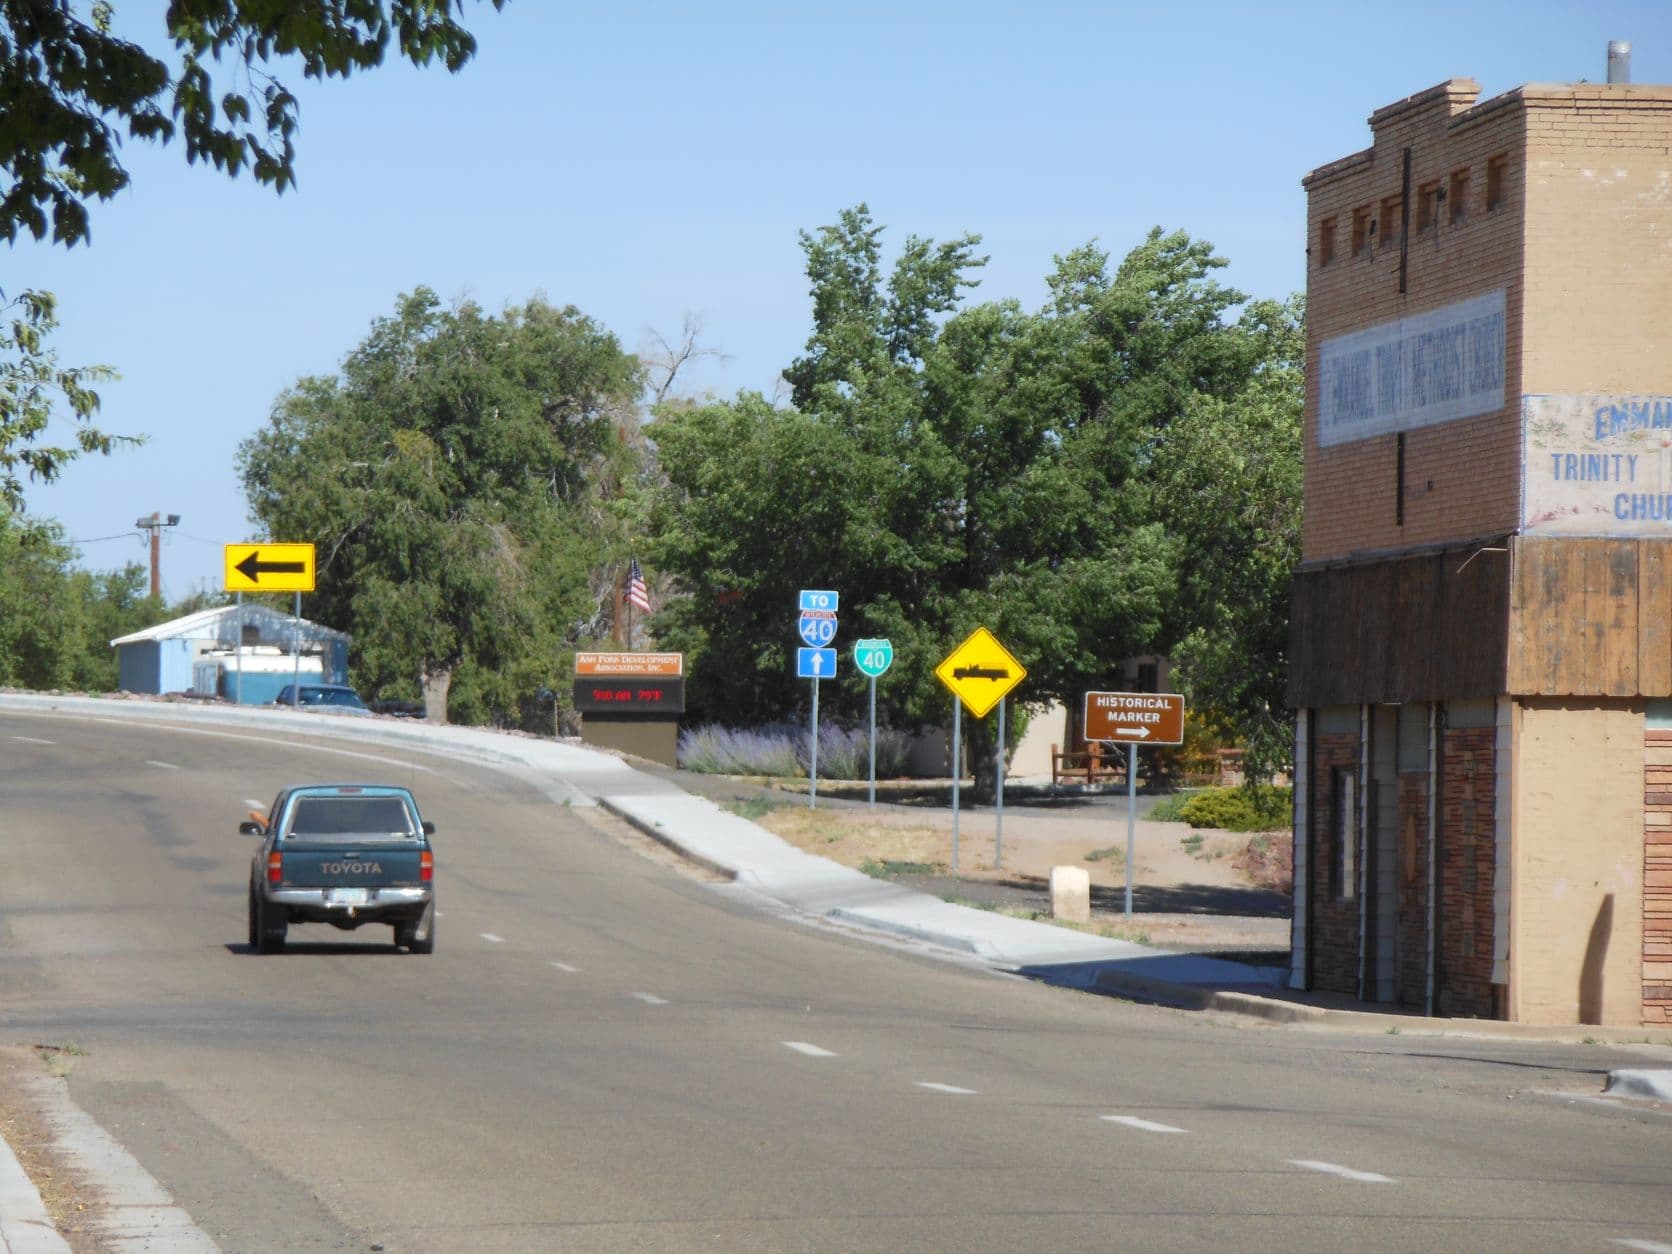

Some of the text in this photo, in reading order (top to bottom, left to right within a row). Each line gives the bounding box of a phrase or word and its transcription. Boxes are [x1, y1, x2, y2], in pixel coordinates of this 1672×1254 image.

[1551, 453, 1638, 482] TRINITY
[810, 595, 829, 607] TO
[803, 620, 834, 641] 40
[863, 651, 885, 669] 40
[1097, 696, 1172, 709] HISTORICAL
[1108, 711, 1160, 723] MARKER
[320, 862, 382, 875] TOYOTA
